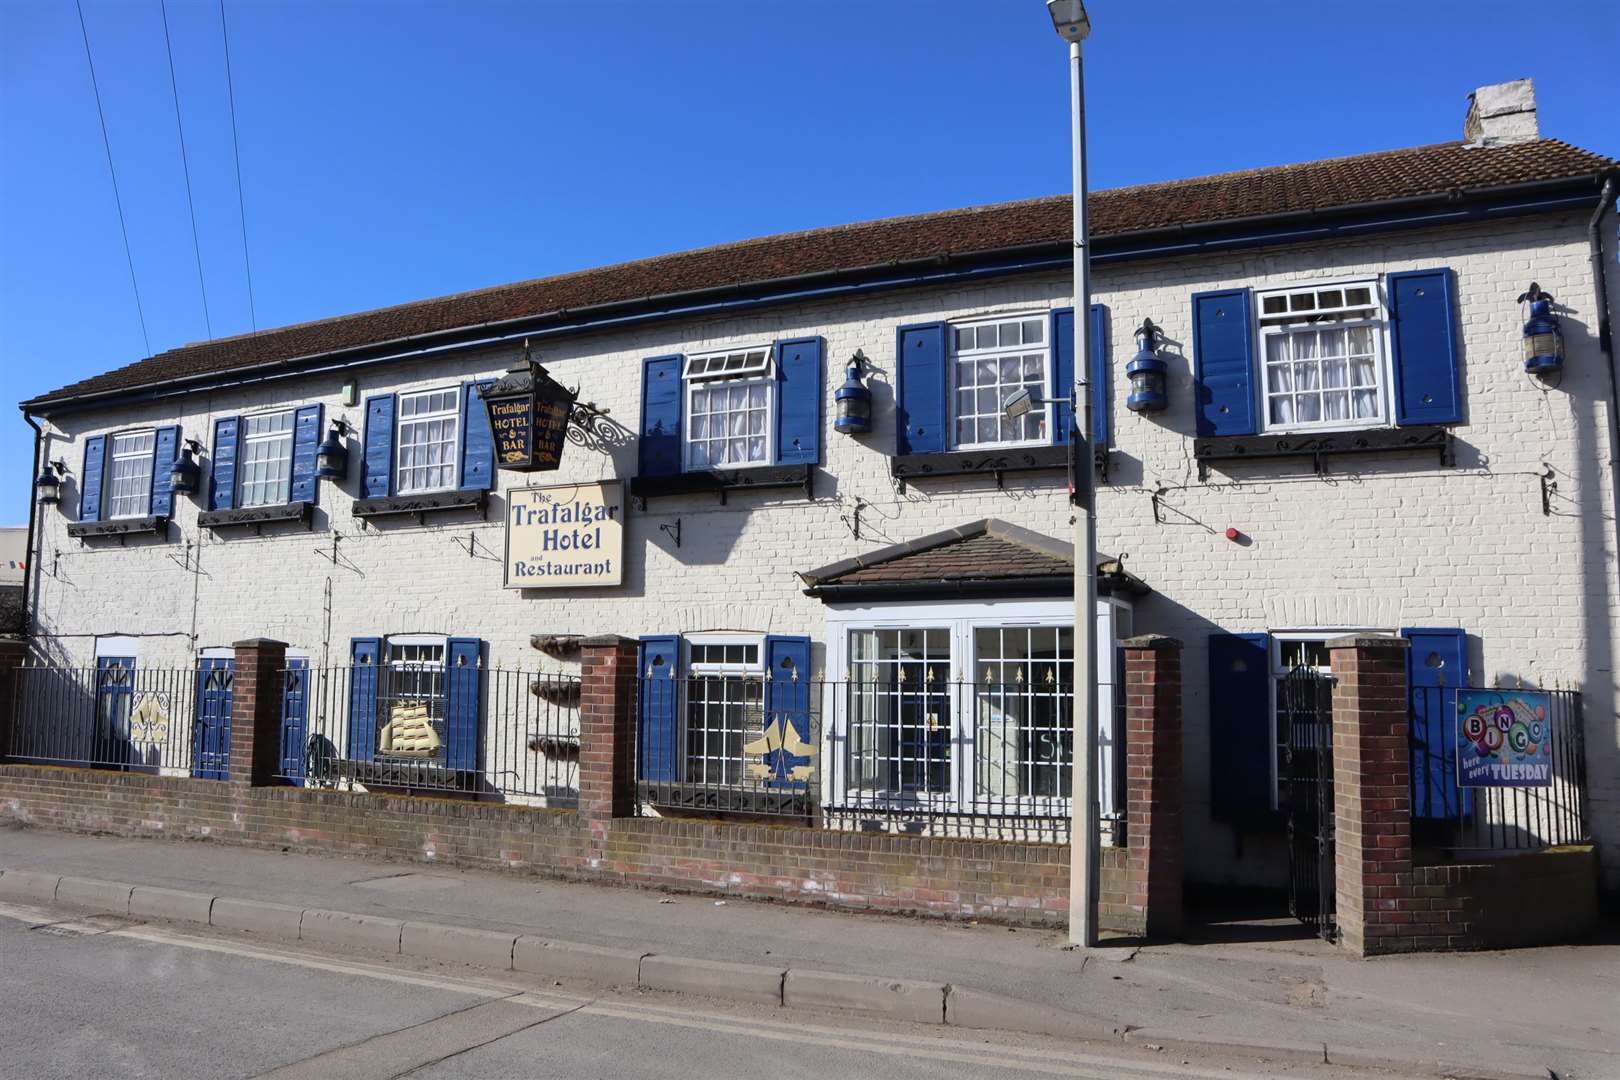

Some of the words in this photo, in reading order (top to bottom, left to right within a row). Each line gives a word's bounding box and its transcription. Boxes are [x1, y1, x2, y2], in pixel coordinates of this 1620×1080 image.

[492, 403, 530, 415] Trafalgar
[494, 417, 529, 429] HOTEL
[503, 440, 525, 450] BAR
[531, 492, 552, 504] The
[512, 501, 619, 527] Trafalgar
[542, 527, 600, 551] Hotel
[515, 559, 611, 577] Restaurant
[1470, 716, 1540, 749] BINGO
[1463, 757, 1480, 769] here
[1469, 764, 1490, 779] every
[1491, 763, 1549, 780] TUESDAY
